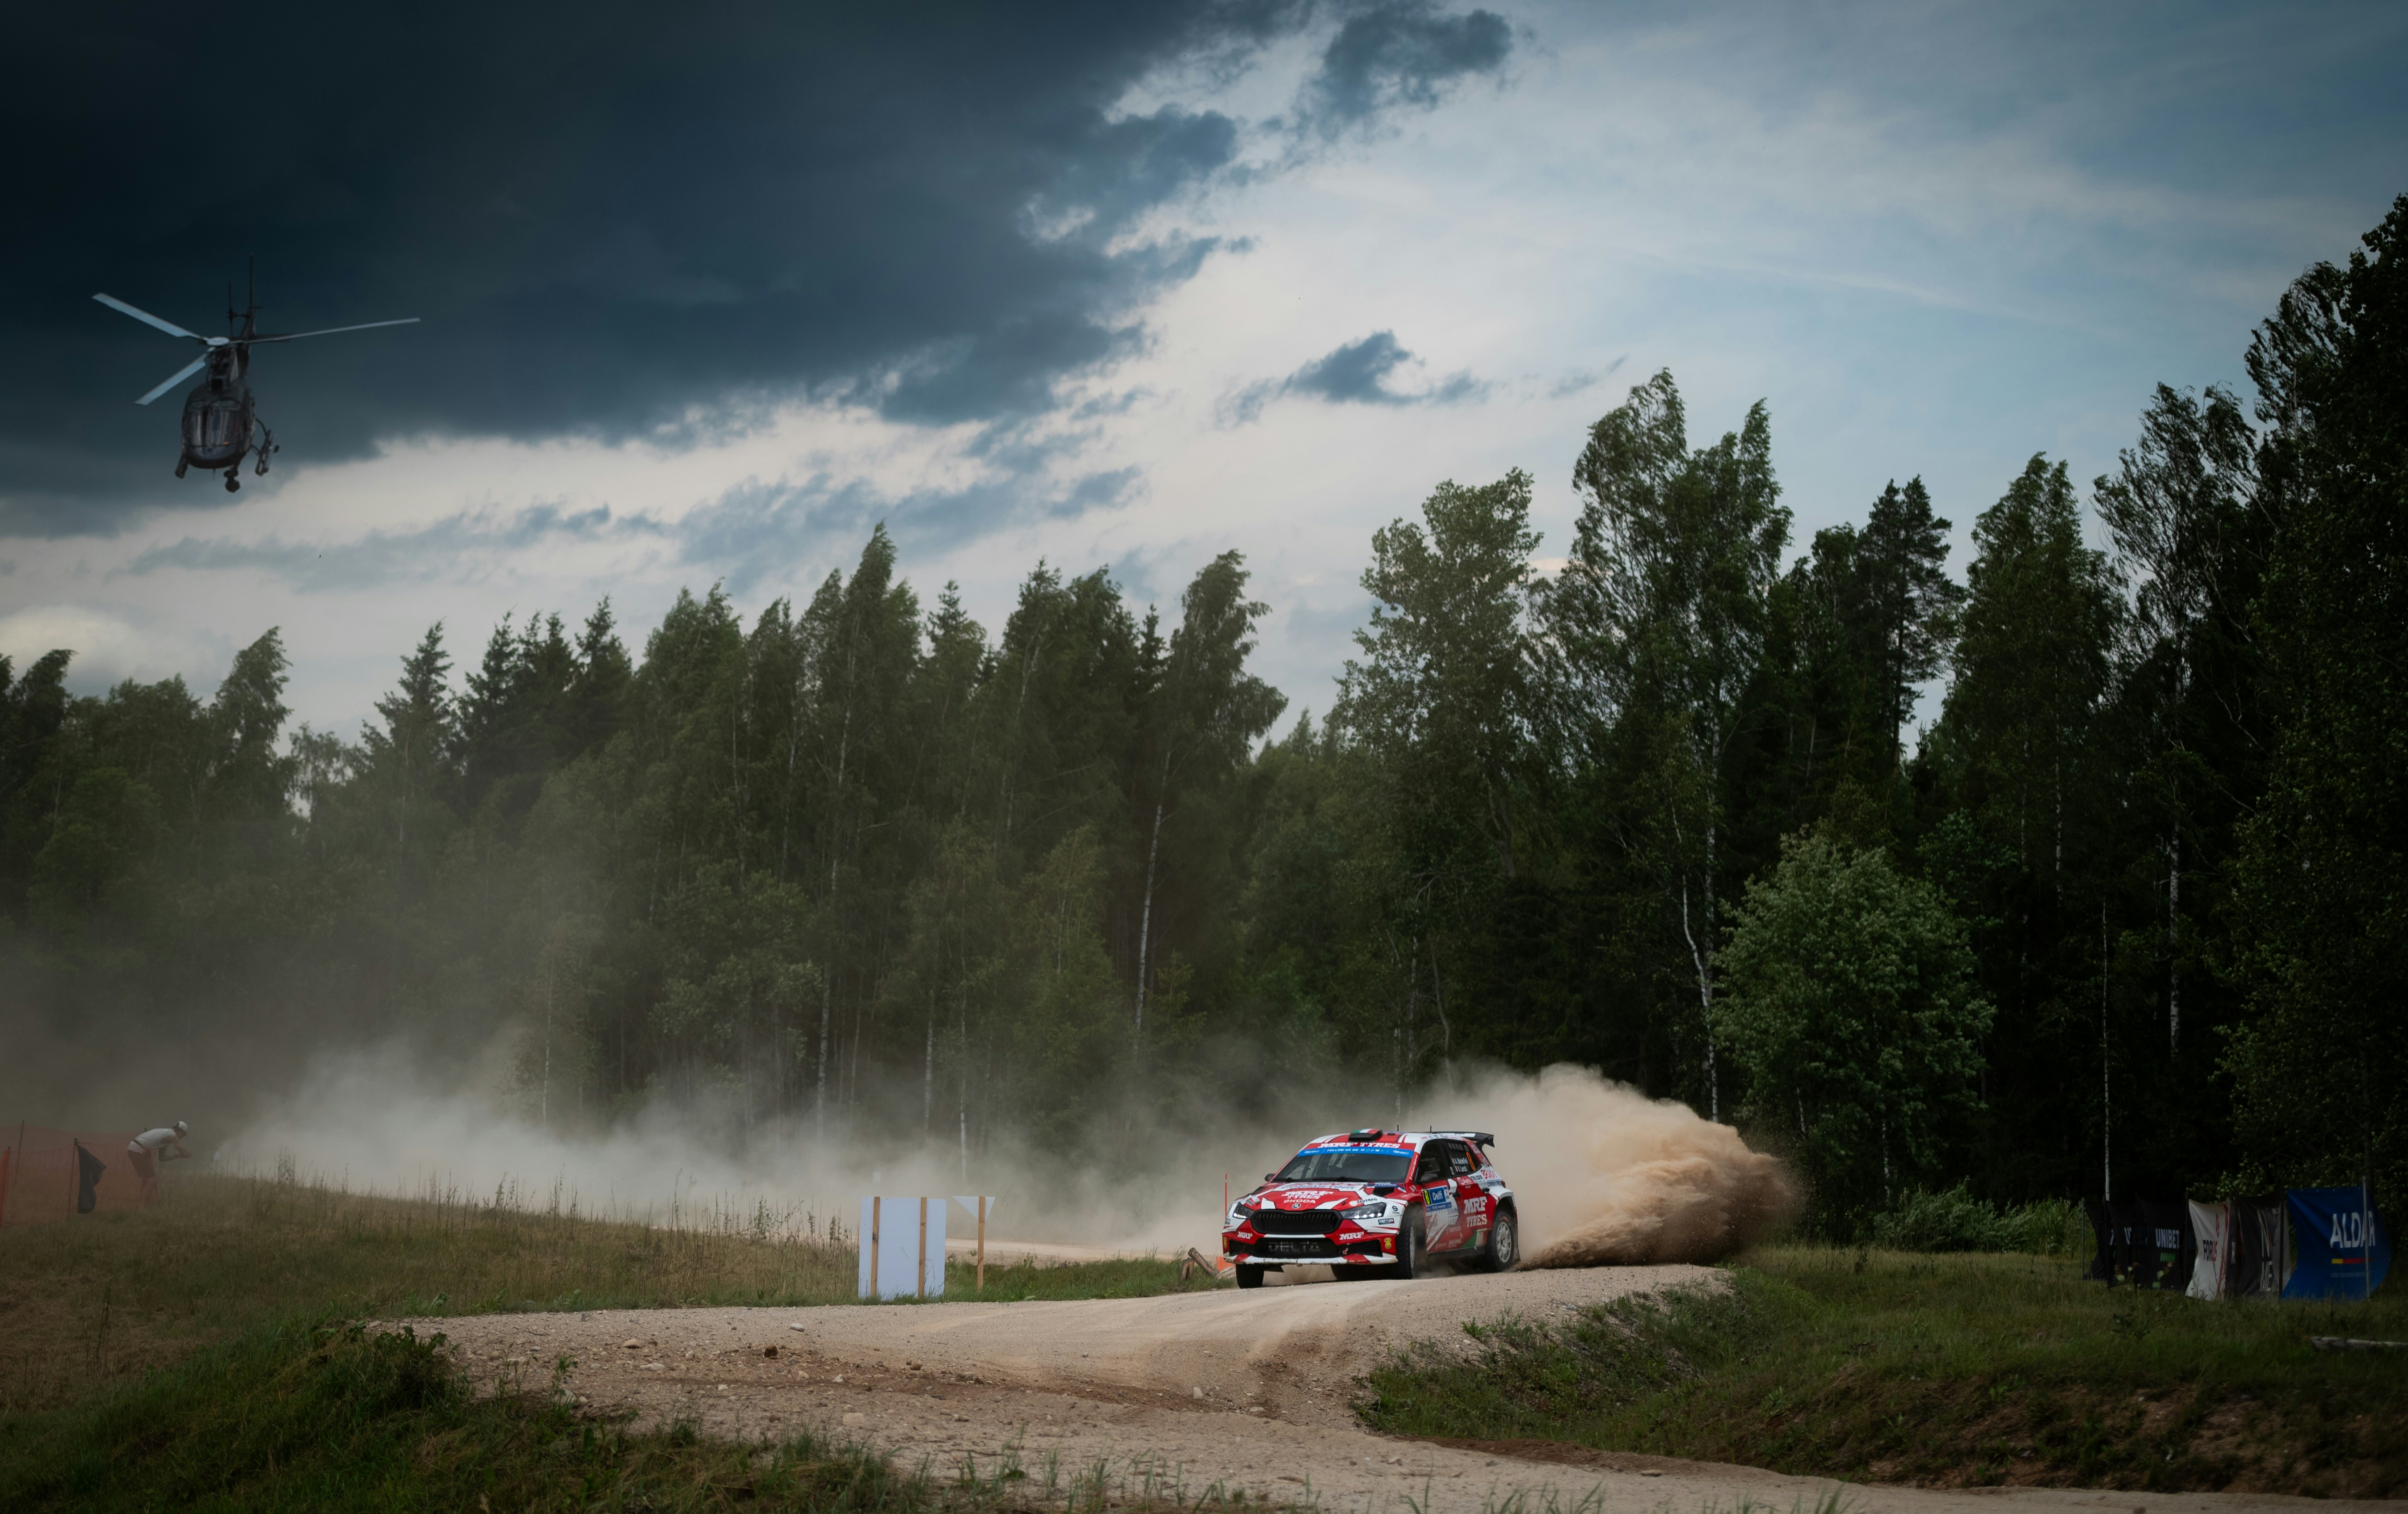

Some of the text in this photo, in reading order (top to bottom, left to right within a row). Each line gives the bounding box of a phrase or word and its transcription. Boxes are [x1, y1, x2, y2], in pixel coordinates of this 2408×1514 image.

[1466, 1152, 1475, 1171] 8
[1424, 1190, 1430, 1205] 8
[1432, 1190, 1443, 1201] Delfi
[1464, 1196, 1487, 1215] MRF
[1466, 1214, 1488, 1228] TYRES
[2330, 1210, 2375, 1248] ALDAR
[1237, 1231, 1253, 1239] MRF
[1339, 1232, 1364, 1240] MRF
[2155, 1228, 2180, 1249] UNIBET
[2202, 1239, 2217, 1262] FORUS
